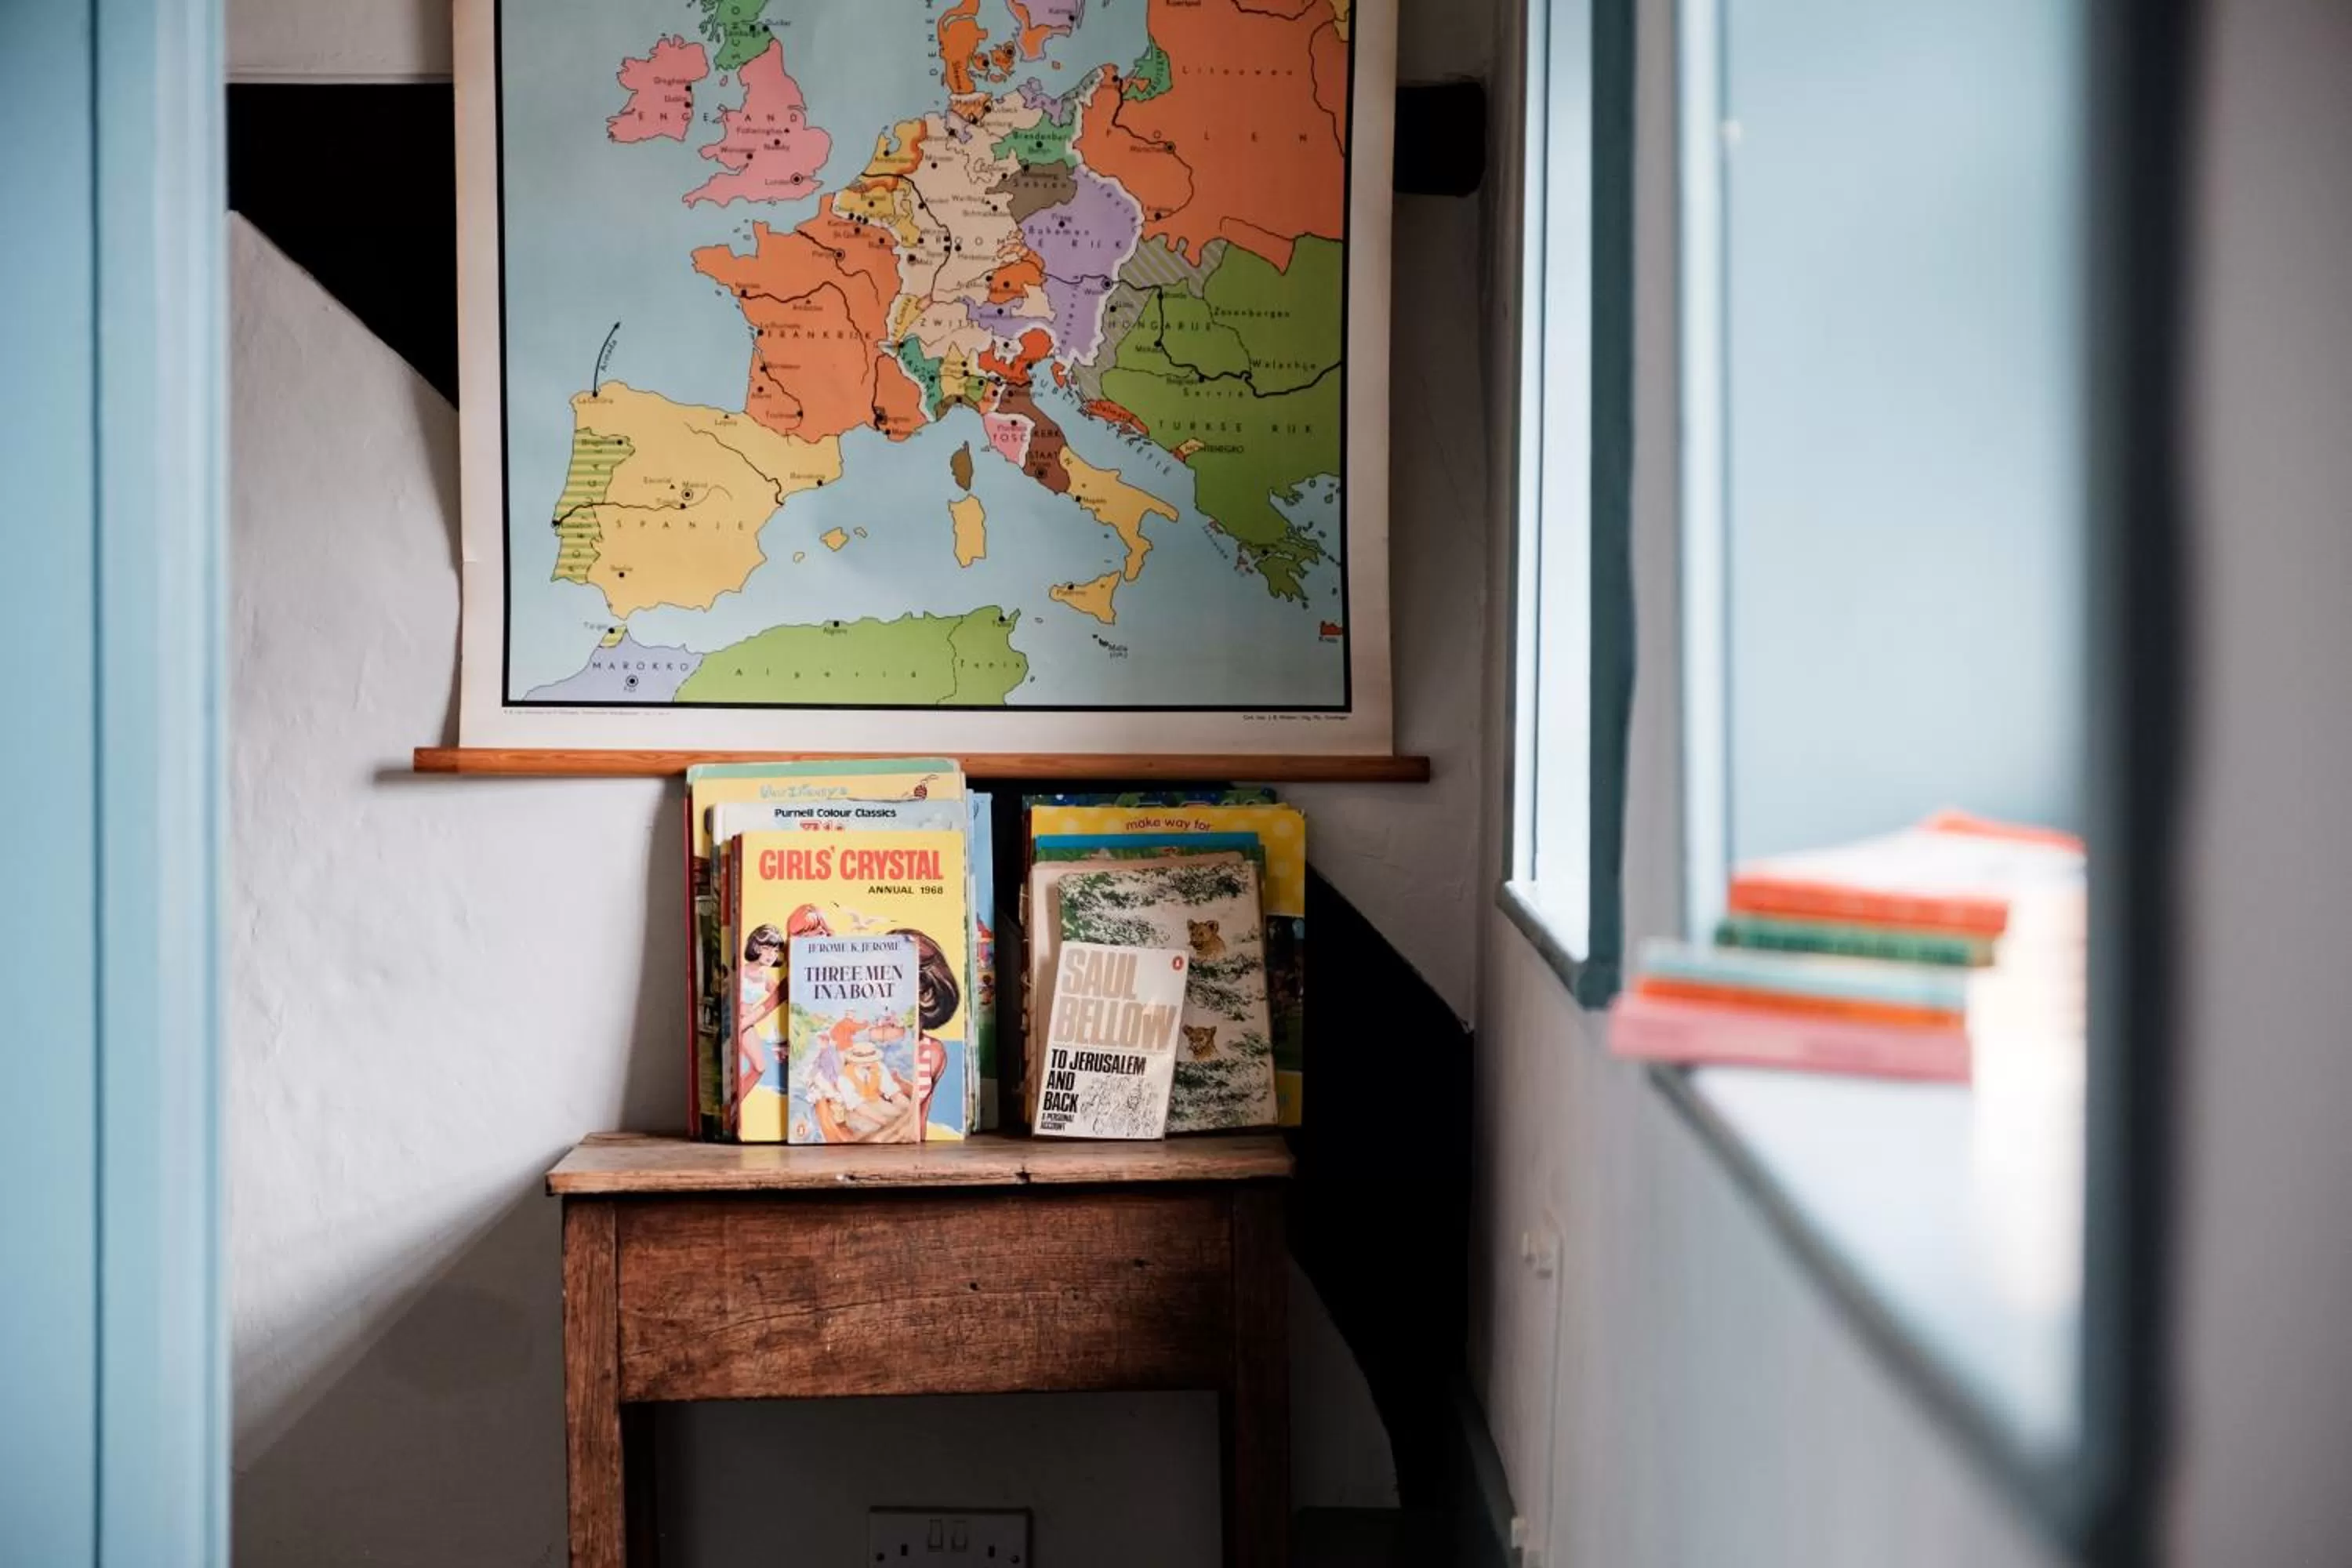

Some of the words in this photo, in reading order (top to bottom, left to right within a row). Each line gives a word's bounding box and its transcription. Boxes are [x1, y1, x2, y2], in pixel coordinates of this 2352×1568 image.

[775, 808, 814, 818] Purnell
[817, 808, 852, 818] Colour
[855, 808, 897, 818] Classics
[1126, 817, 1161, 830] make
[1164, 818, 1190, 830] way
[1193, 818, 1212, 832] for
[759, 845, 835, 880] GIRLS'
[840, 849, 944, 880] CRYSTAL
[868, 885, 914, 895] ANNUAL
[920, 885, 944, 895] 1968
[808, 943, 845, 953] JEROME
[862, 942, 901, 953] JEROME
[805, 966, 864, 983] THREE
[866, 964, 903, 982] MEN
[1062, 948, 1138, 1000] SAUL
[814, 985, 834, 1000] IN
[833, 985, 848, 1000] A
[848, 982, 895, 1000] BOAT
[1053, 996, 1177, 1051] BELLOW
[1051, 1048, 1067, 1070] TO
[1069, 1051, 1147, 1076] JERUSALEM
[1047, 1071, 1075, 1091] AND
[1043, 1091, 1080, 1113] BACK
